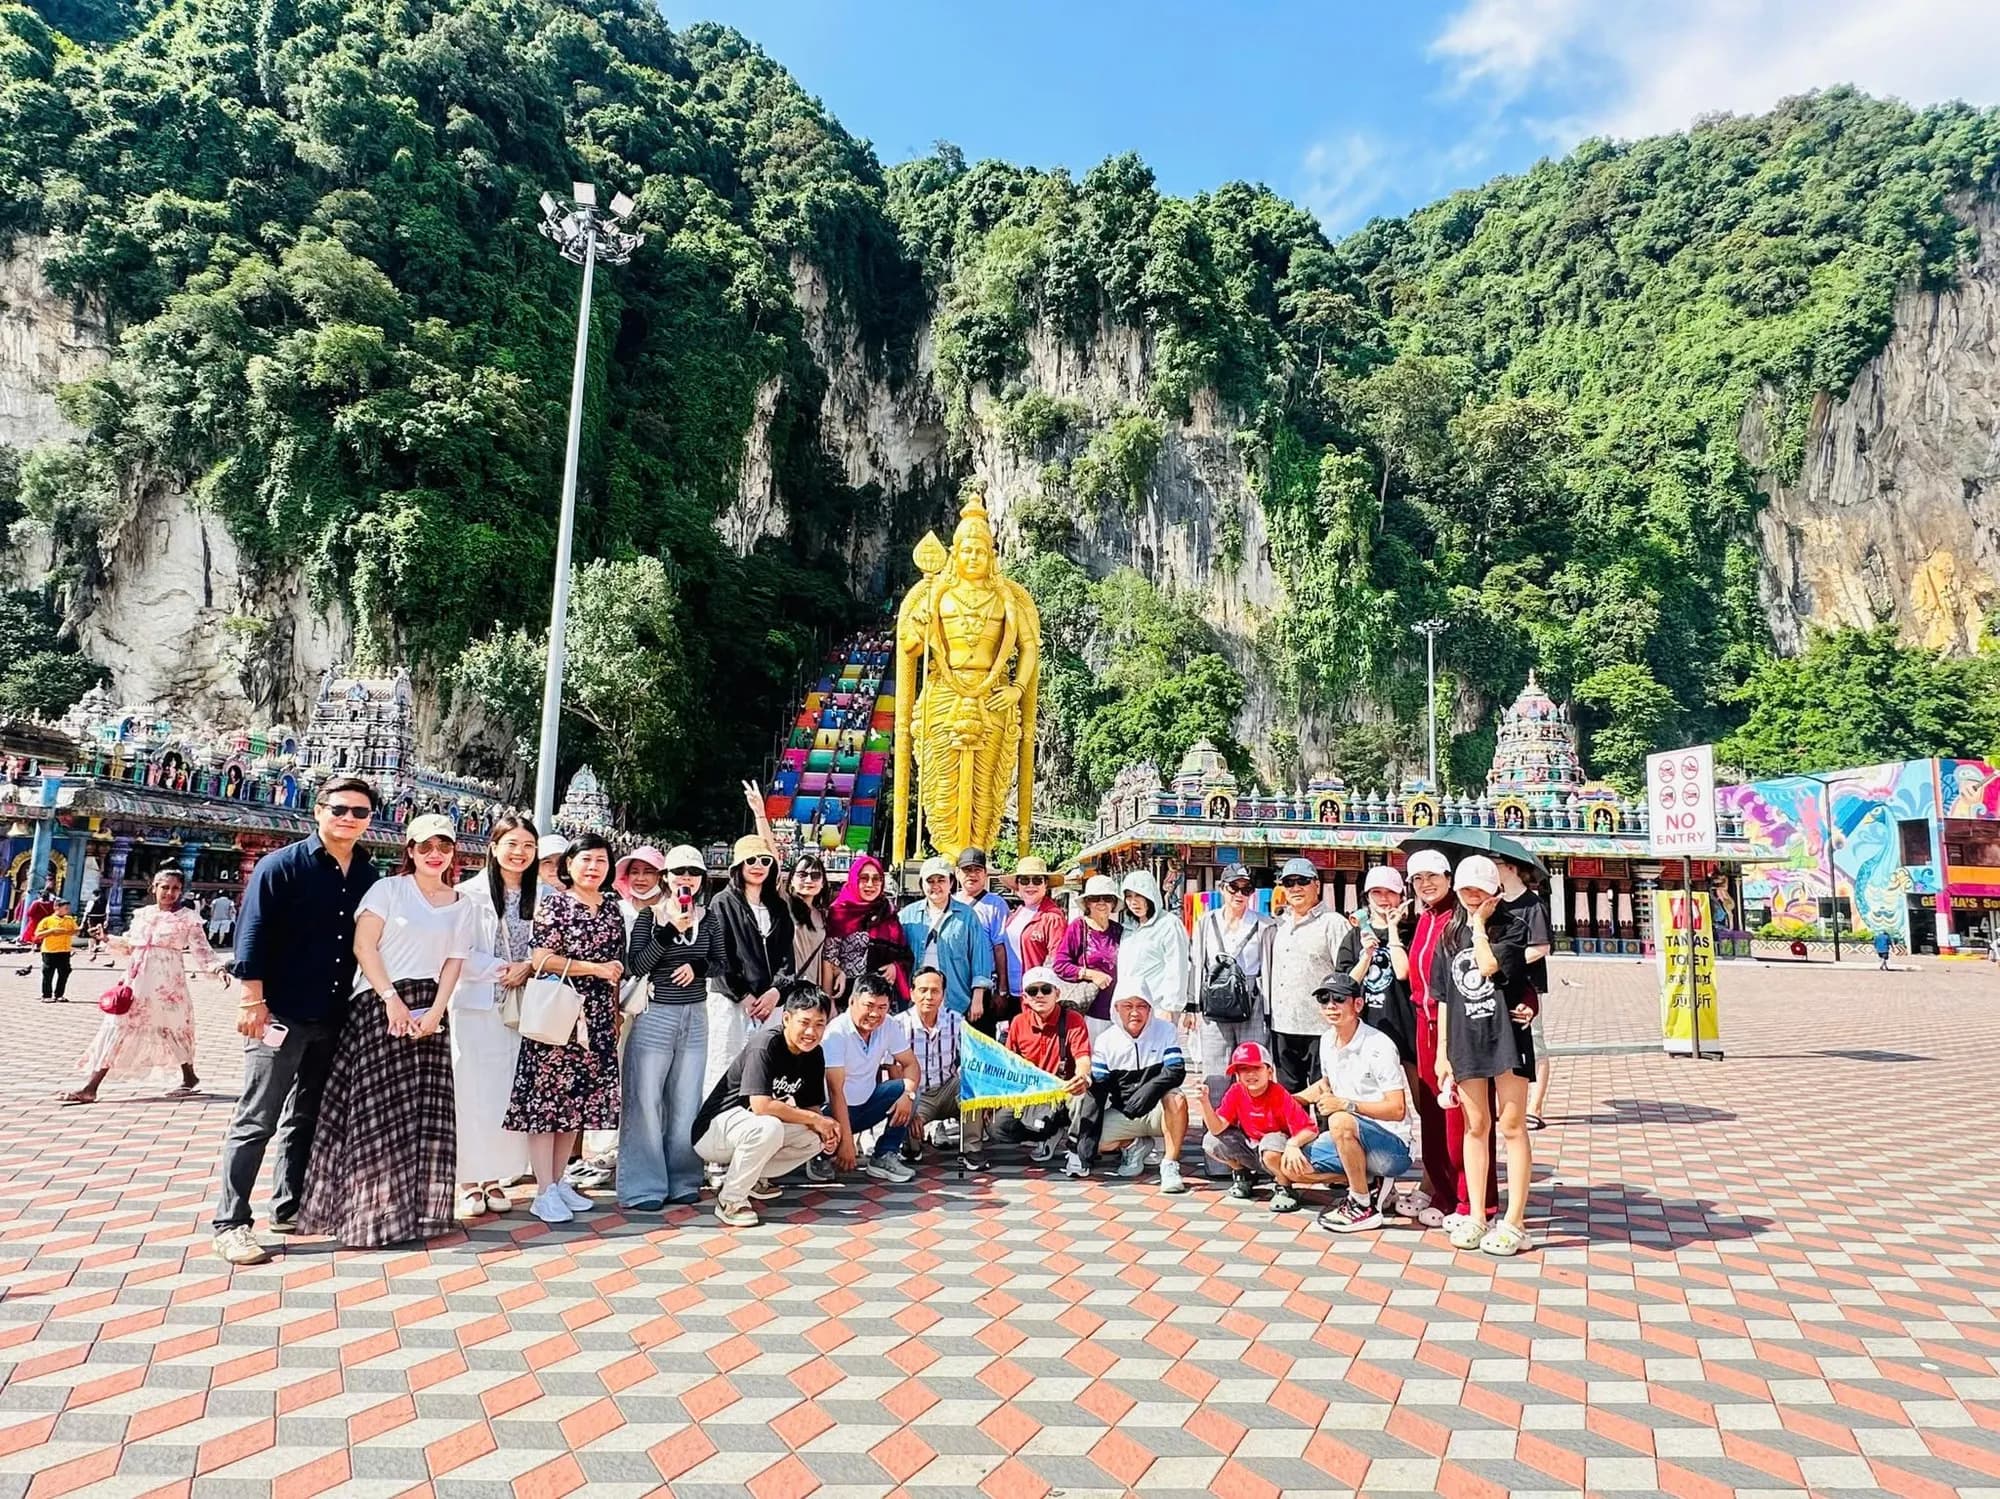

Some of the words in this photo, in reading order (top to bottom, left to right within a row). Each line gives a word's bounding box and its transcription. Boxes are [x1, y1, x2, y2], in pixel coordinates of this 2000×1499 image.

[1666, 812, 1696, 830] NO
[1656, 831, 1706, 846] ENTRY
[1921, 895, 1978, 908] GEHA'S
[1666, 934, 1710, 948] TANAS
[1670, 953, 1709, 967] TOIET
[983, 1063, 1007, 1079] MINH
[1007, 1070, 1019, 1083] DU
